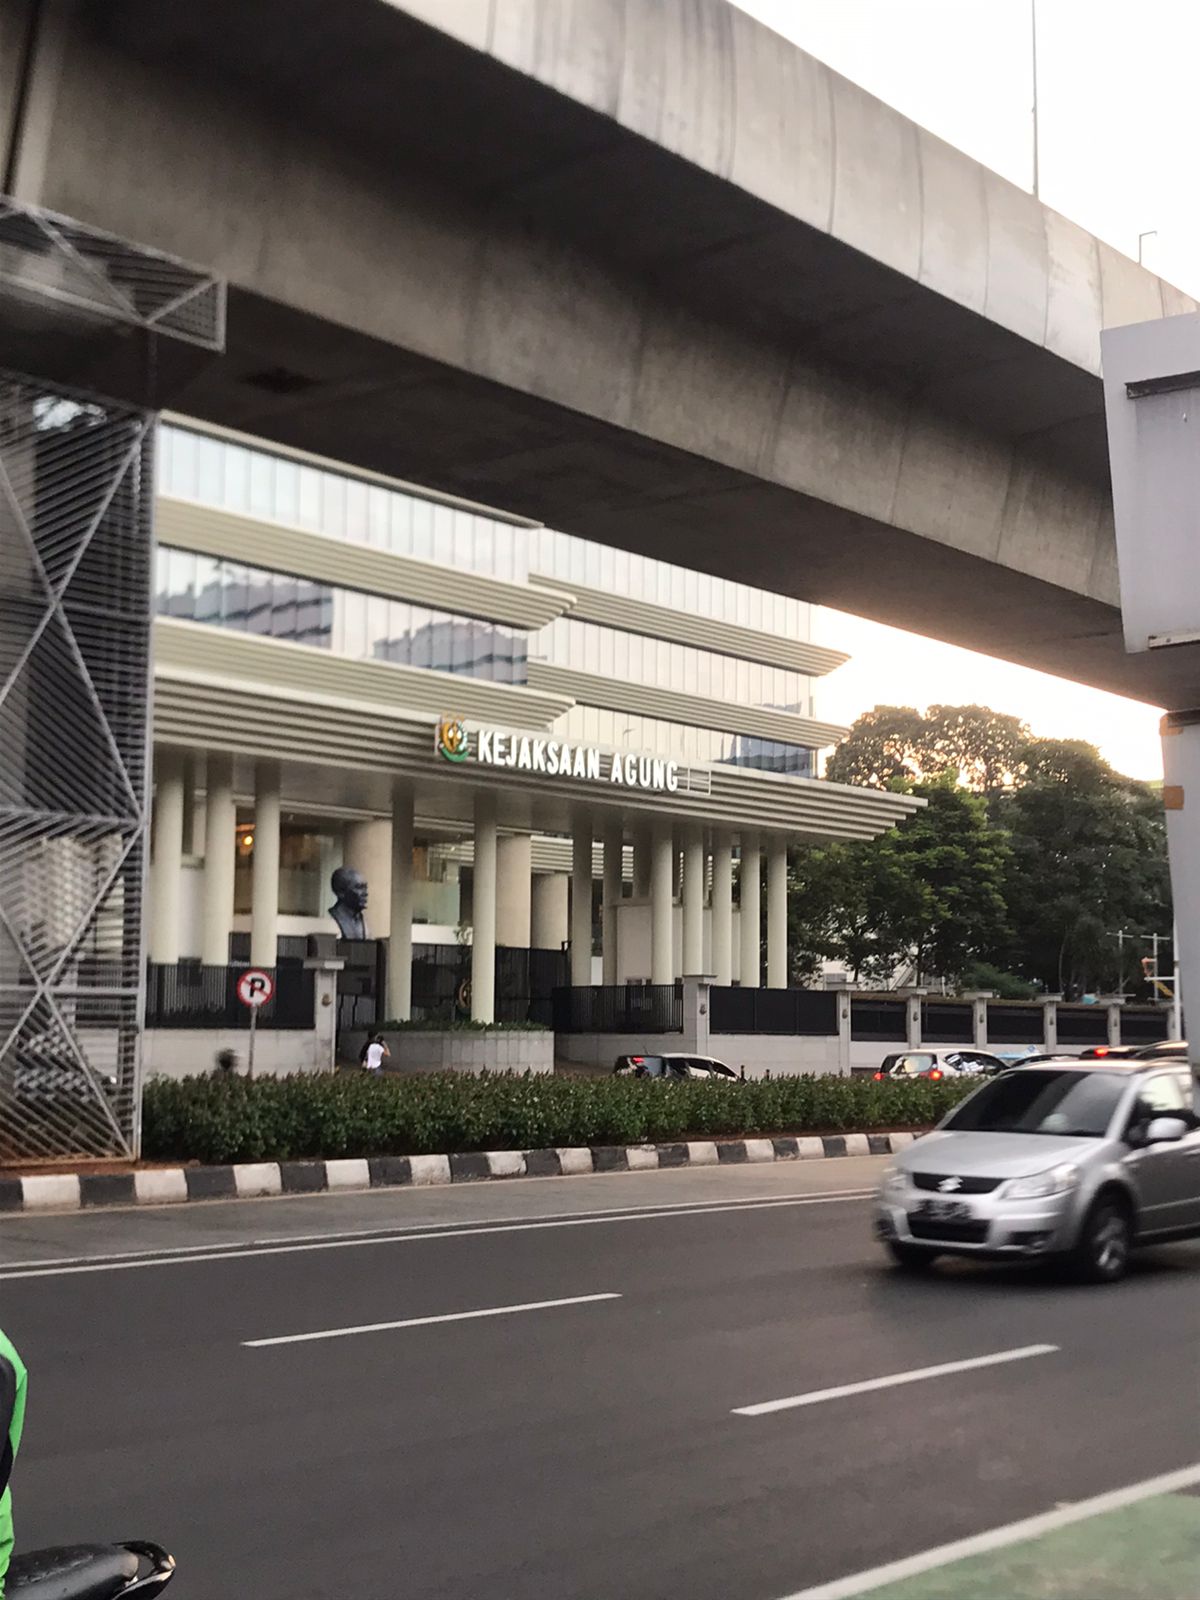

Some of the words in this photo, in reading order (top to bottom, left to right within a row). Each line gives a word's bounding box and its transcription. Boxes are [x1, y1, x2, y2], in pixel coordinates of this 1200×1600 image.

[478, 729, 600, 779] KEJAKSAAN
[611, 752, 678, 791] AGUNG
[249, 977, 265, 998] P
